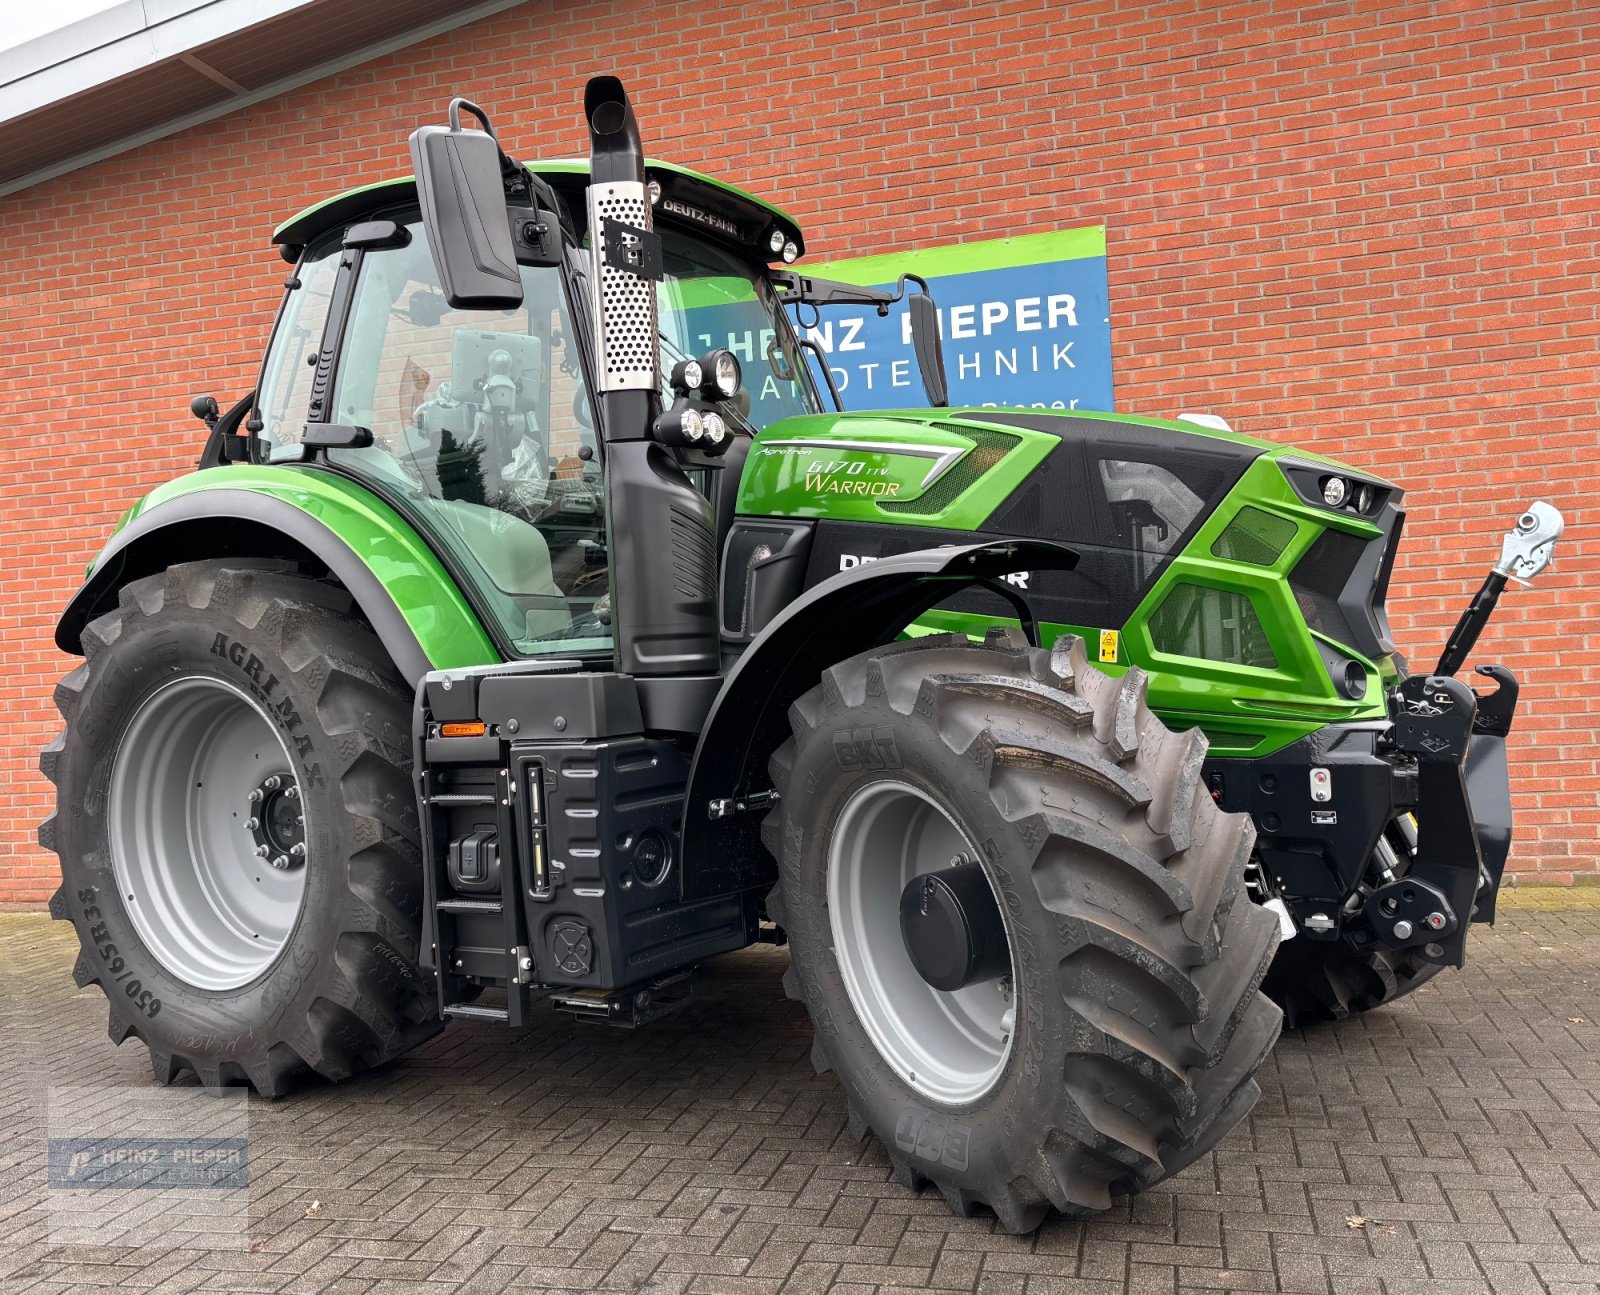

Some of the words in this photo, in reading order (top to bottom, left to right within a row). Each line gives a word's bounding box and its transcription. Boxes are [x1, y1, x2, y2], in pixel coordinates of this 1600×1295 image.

[663, 200, 738, 236] DEUTZ-FAHR
[755, 447, 812, 456] Agrotron
[807, 460, 867, 475] 6170
[866, 468, 890, 476] TTV
[805, 473, 900, 497] WARRIOR
[78, 887, 162, 1019] 650/65R38
